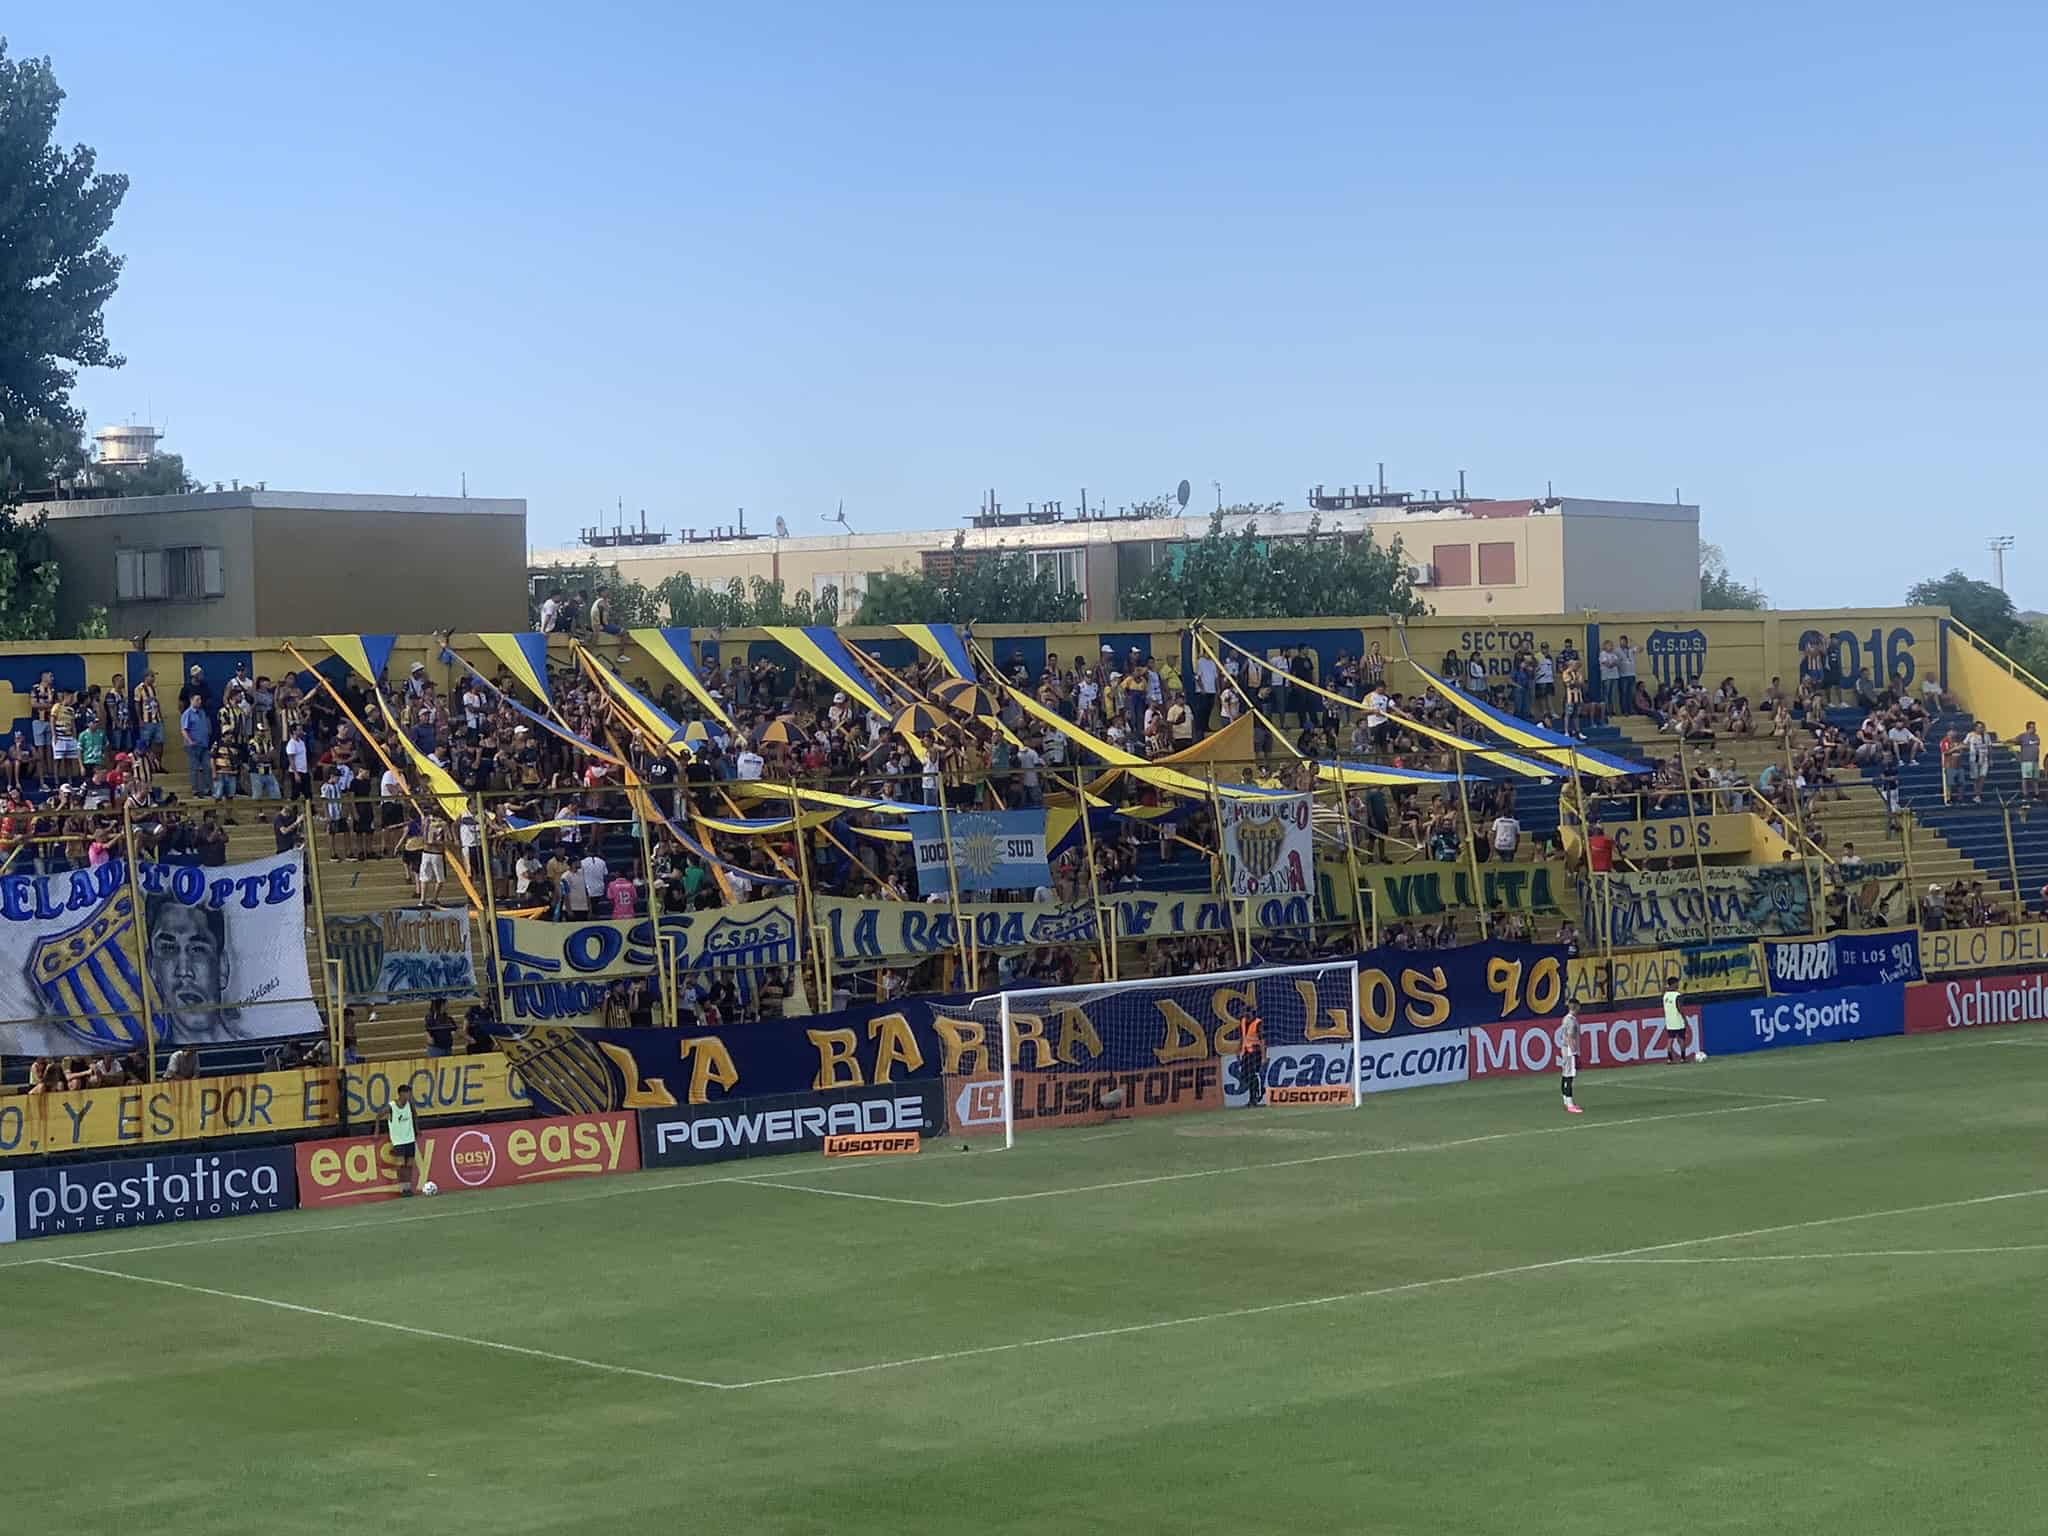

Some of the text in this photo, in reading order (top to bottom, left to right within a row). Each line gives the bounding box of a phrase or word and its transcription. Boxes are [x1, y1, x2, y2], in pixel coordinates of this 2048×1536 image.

[1462, 631, 1534, 651] SECTOR
[920, 839, 1034, 863] DOC SUD
[1615, 821, 1718, 852] C.S.D.S.
[496, 914, 695, 973] LOS
[1776, 942, 1838, 981] BARRA
[1843, 951, 1857, 965] DE
[1862, 949, 1887, 964] LOS
[1891, 942, 1912, 968] 90
[1751, 999, 1861, 1041] TyC Sports
[1946, 975, 2048, 1027] Schneid
[600, 957, 1561, 1109] LA BARRA DE LOS 90
[1223, 1042, 1467, 1097] Scaelec.com
[63, 1100, 93, 1144] Y
[117, 1092, 175, 1141] ES
[200, 1083, 273, 1129] POR
[409, 1064, 485, 1109] QUE
[656, 1095, 925, 1154] POWERADE
[310, 1137, 436, 1191] easy
[455, 1149, 491, 1167] easy
[507, 1119, 627, 1170] easy
[41, 1198, 280, 1231] INTERNACIONAL
